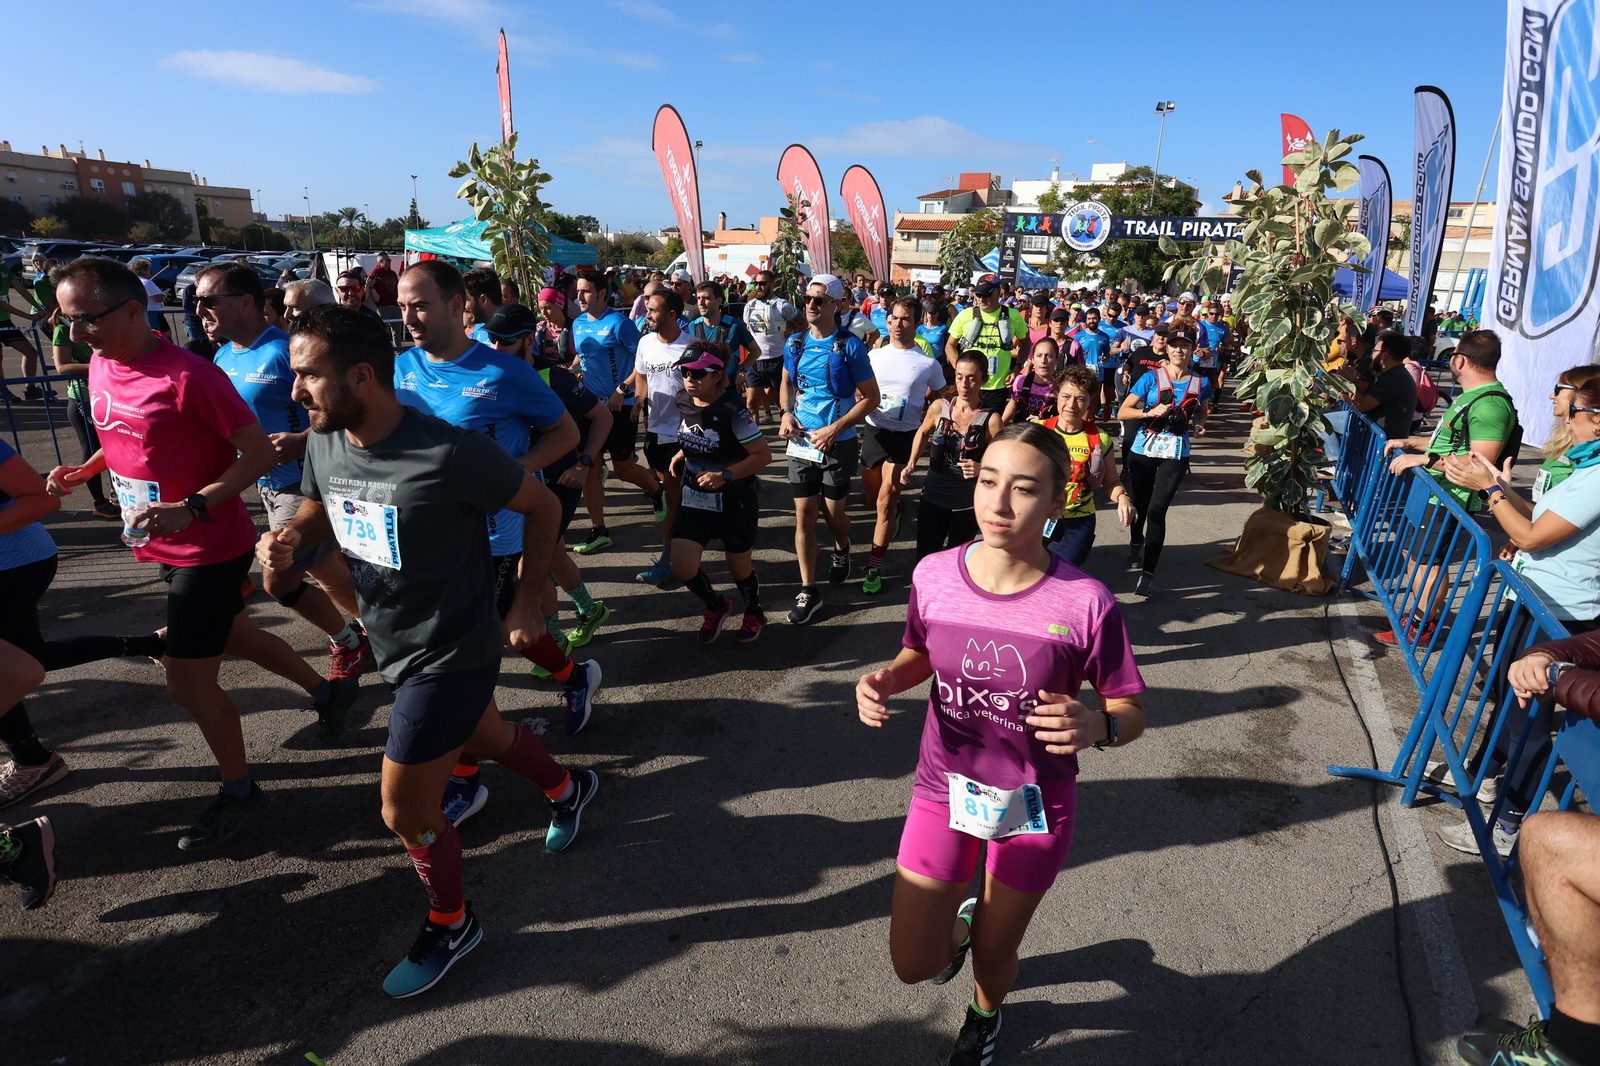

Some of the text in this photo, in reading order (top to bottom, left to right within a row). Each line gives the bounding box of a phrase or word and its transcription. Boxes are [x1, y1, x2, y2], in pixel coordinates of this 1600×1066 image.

[1124, 220, 1177, 236] TRAIL
[463, 386, 498, 395] LIBERTIUM
[329, 475, 348, 486] XXXVI
[348, 479, 367, 488] MEDIA
[367, 481, 397, 491] MARATÓN
[689, 488, 709, 501] 946
[343, 518, 377, 541] 738
[386, 510, 399, 566] PIRATILLA
[964, 797, 1009, 823] 817
